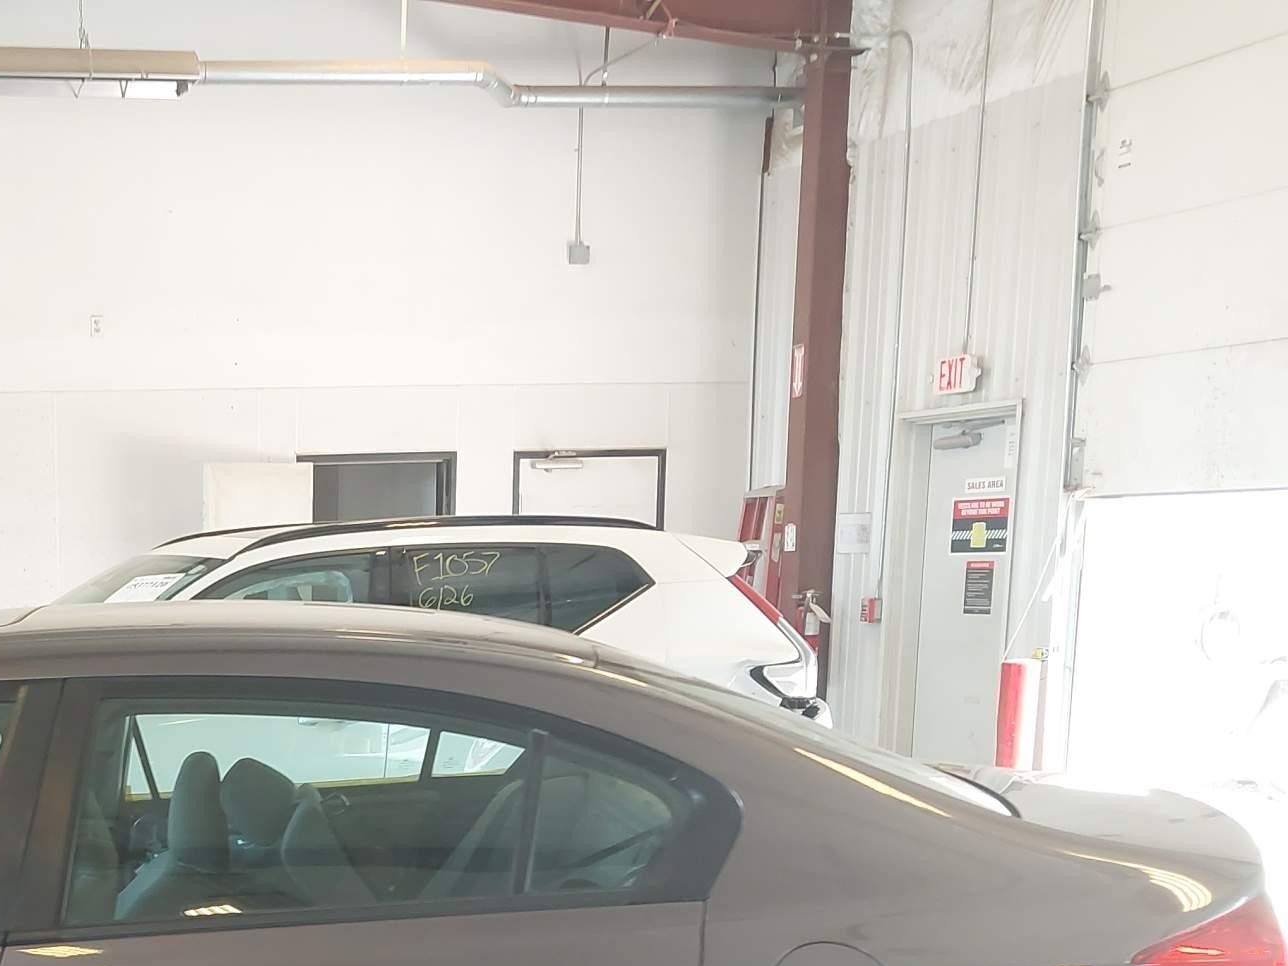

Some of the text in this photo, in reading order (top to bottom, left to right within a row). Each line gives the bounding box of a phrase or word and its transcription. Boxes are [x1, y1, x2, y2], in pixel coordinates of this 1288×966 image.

[938, 357, 966, 391] EXIT
[967, 479, 1004, 490] SALES AREA
[413, 551, 501, 585] F1057
[418, 585, 474, 612] 6/26
